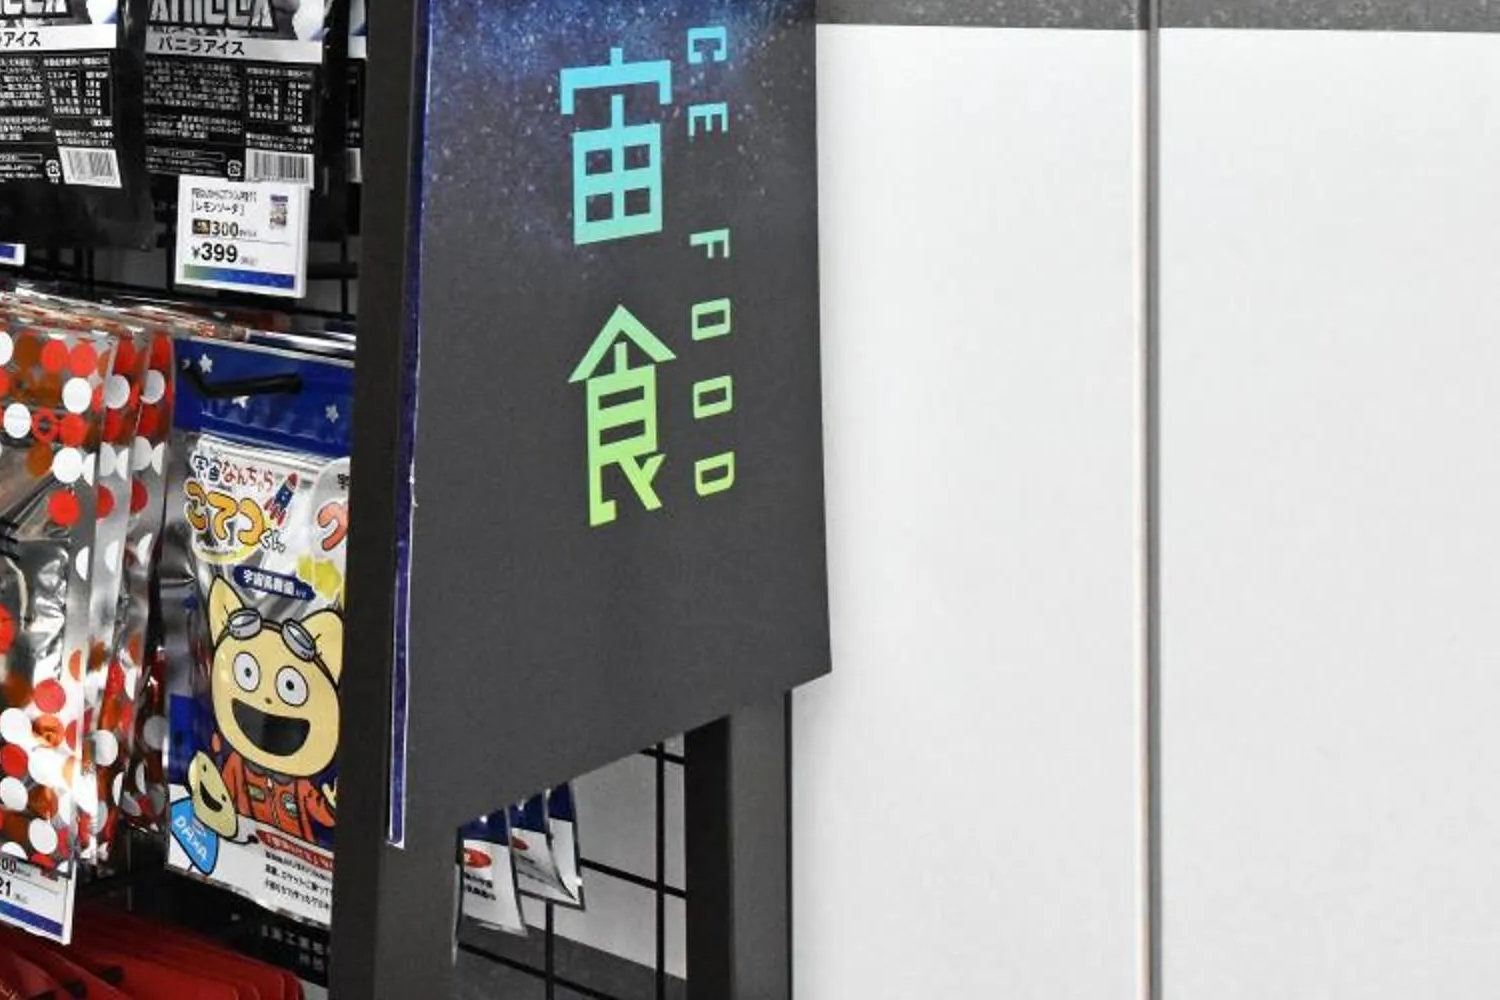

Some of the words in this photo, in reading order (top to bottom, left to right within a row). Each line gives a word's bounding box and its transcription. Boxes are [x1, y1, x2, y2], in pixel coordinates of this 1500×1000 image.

[159, 38, 245, 55] バニラアイス
[211, 221, 239, 237] 300
[191, 242, 238, 263] ¥399
[689, 228, 735, 497] FOOD
